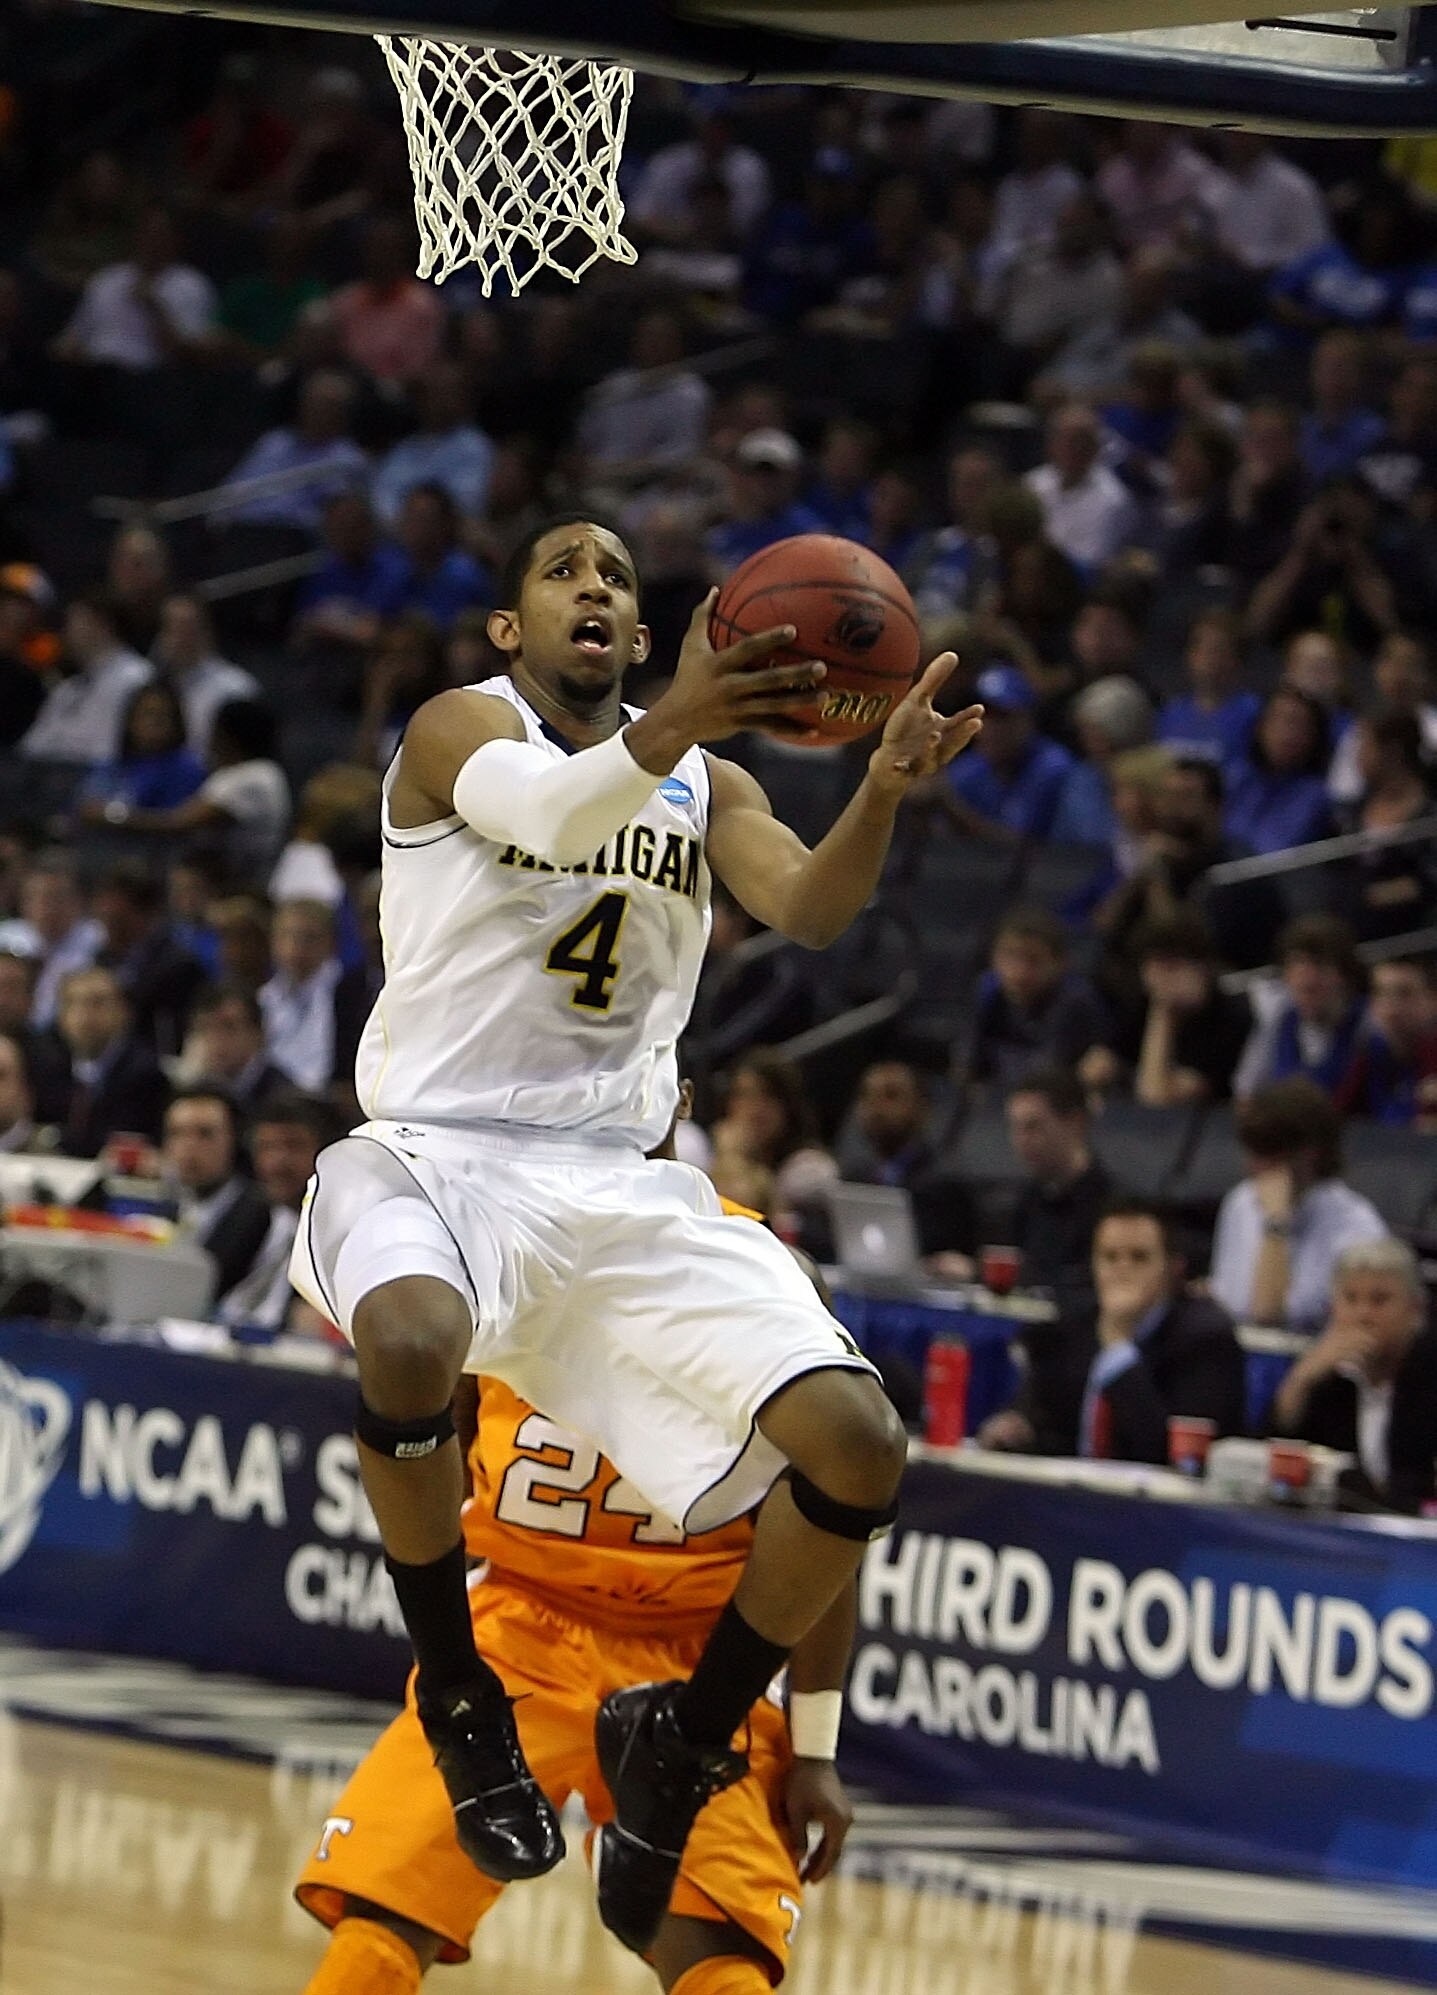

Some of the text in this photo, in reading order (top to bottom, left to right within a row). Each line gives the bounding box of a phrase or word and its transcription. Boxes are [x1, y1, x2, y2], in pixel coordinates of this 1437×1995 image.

[542, 887, 631, 1014] 4
[859, 1530, 1053, 1656] HIRD
[1067, 1556, 1434, 1720] ROUNDS
[850, 1641, 1161, 1777] CAROLINA
